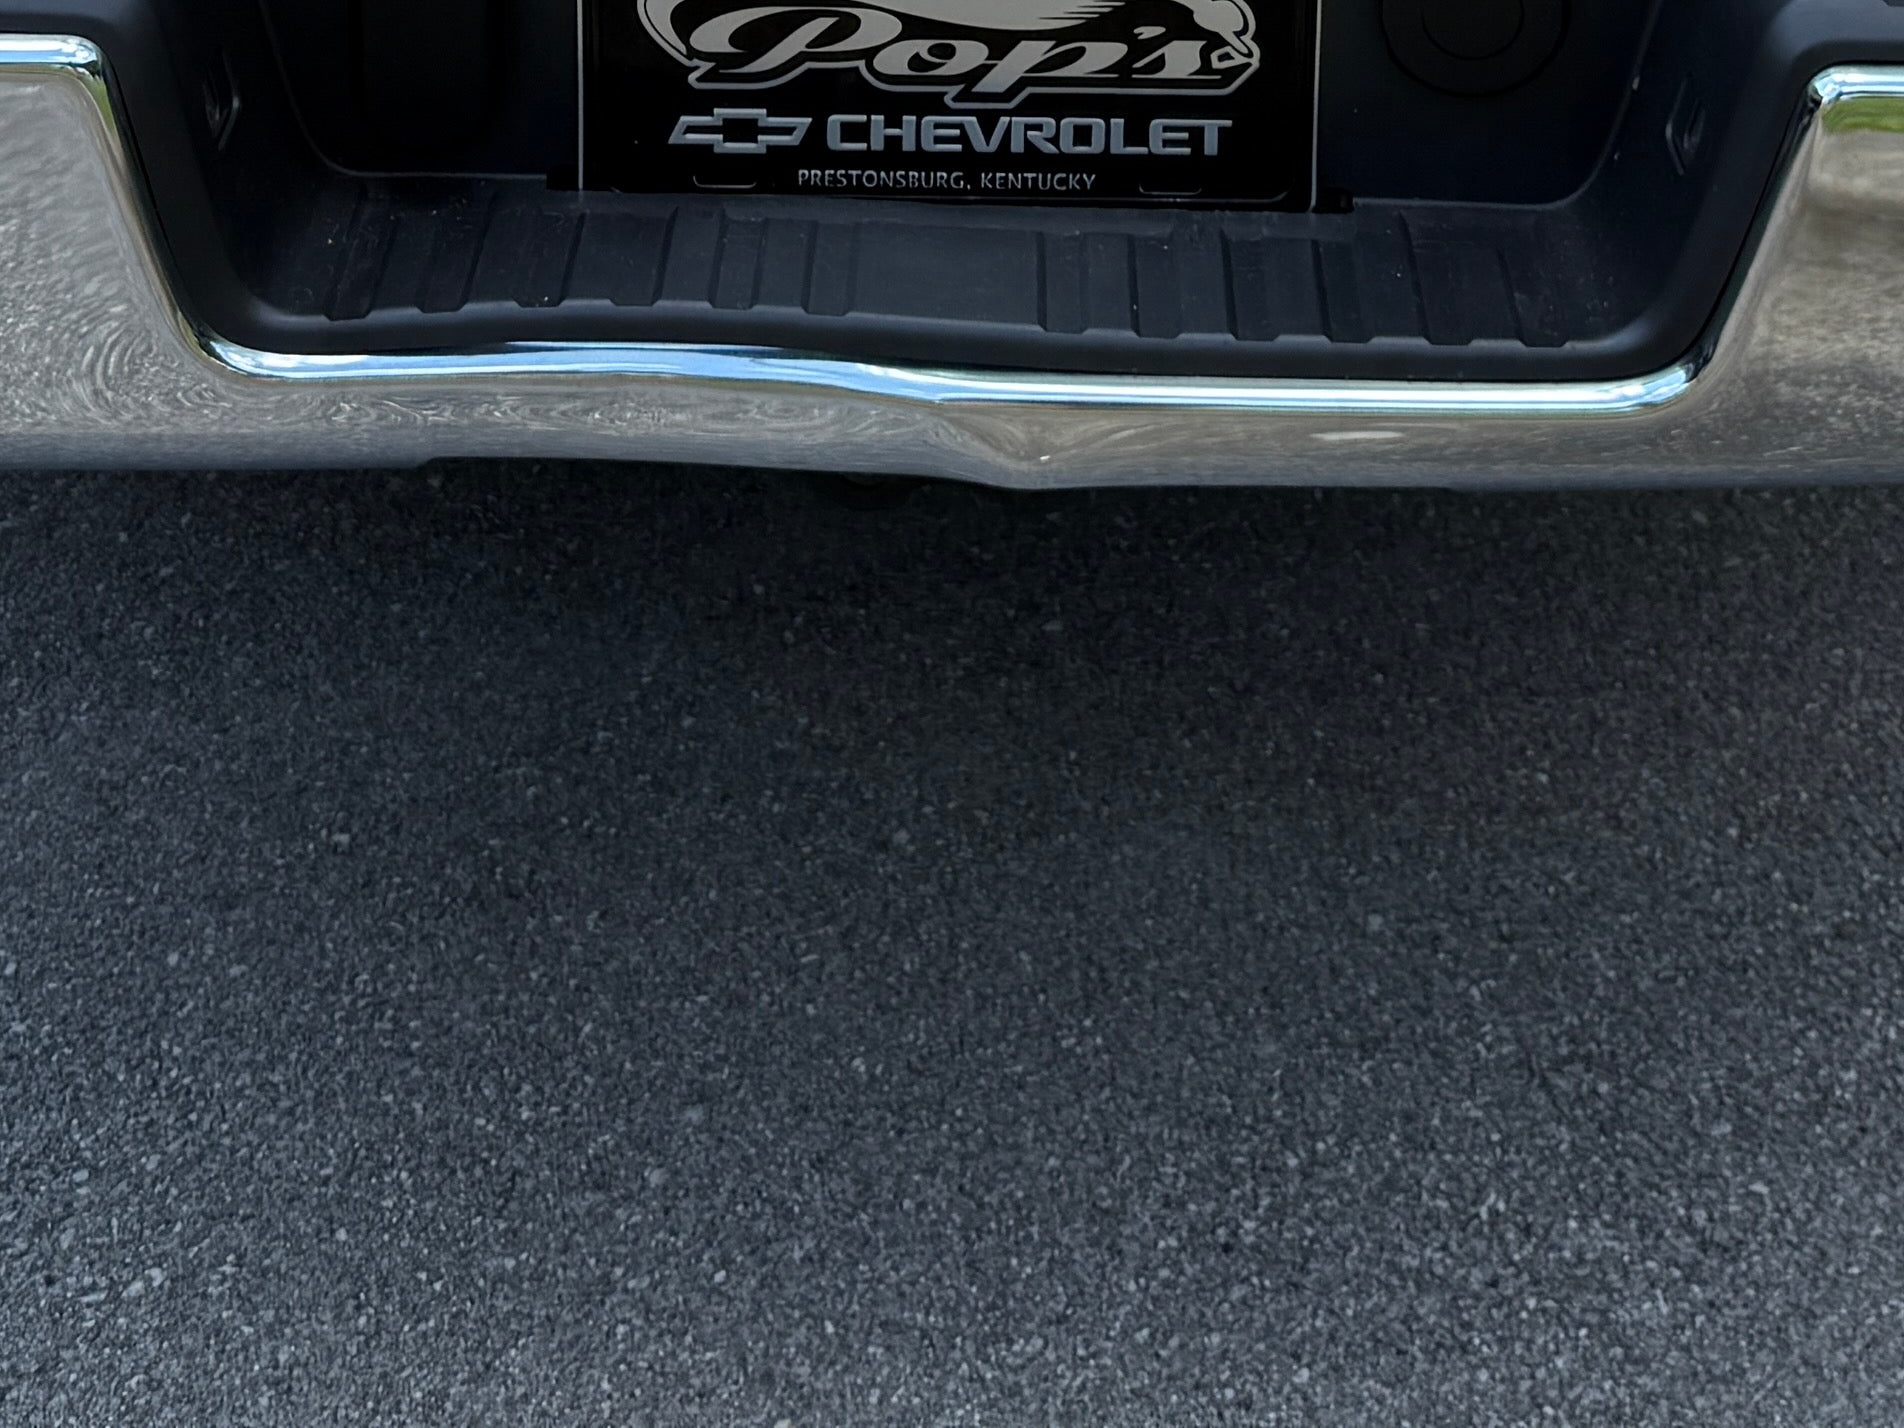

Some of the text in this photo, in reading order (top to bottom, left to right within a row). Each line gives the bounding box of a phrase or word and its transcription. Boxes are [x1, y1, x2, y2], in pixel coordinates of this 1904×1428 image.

[826, 114, 1233, 156] CHEVROLET
[797, 168, 1096, 192] PRESTONSBURG, KENTUCKY
